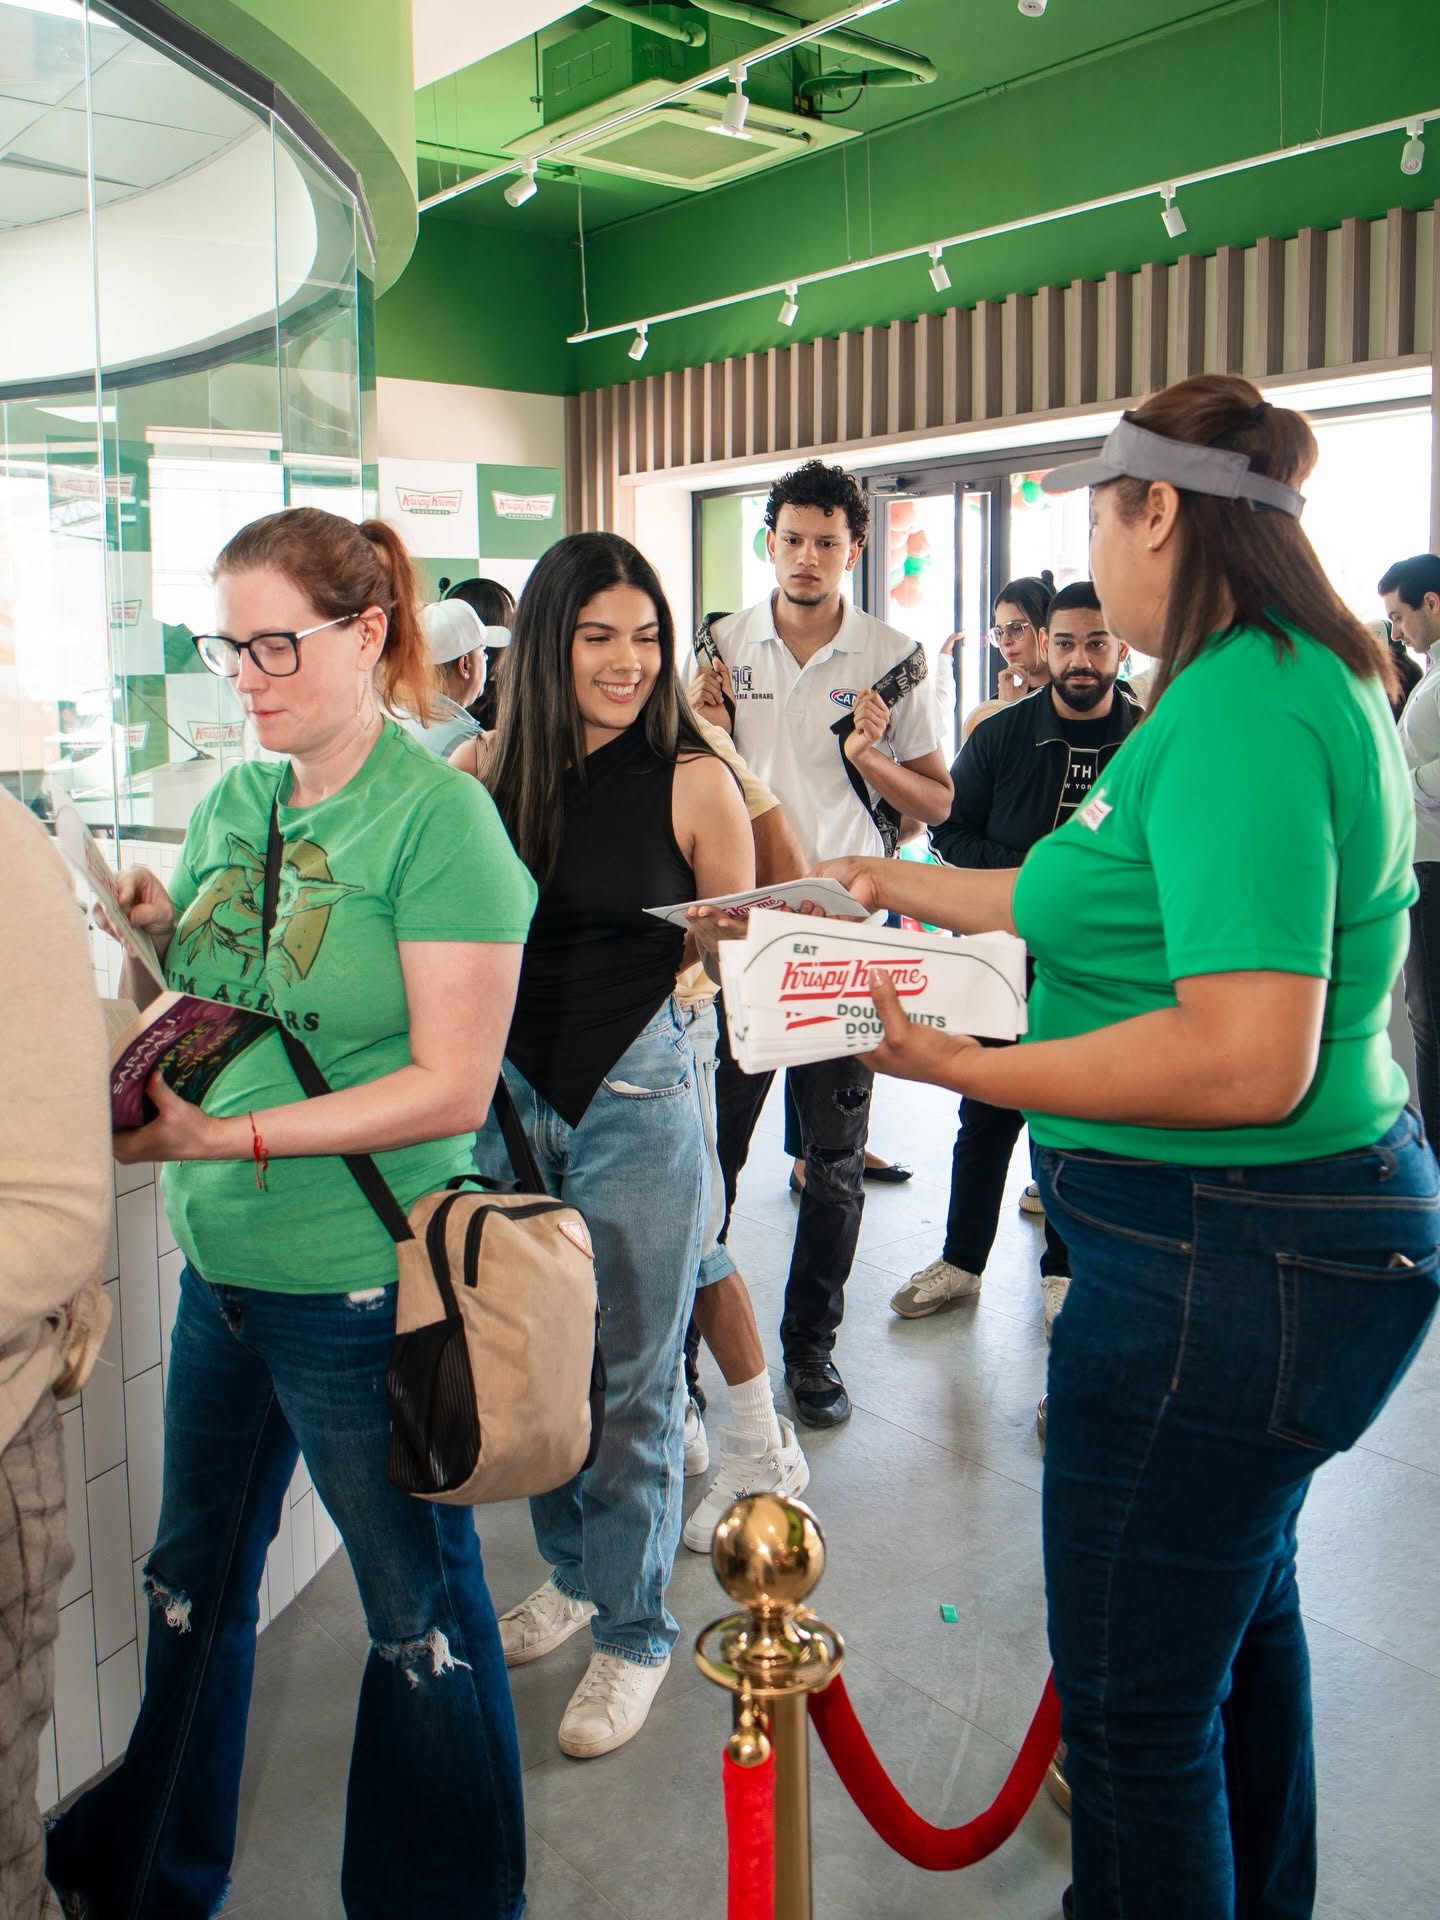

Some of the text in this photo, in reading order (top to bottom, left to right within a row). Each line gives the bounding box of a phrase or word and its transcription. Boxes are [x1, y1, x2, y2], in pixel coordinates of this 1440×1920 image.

[793, 943, 819, 956] EAT
[779, 959, 928, 1002] Krispy Kme
[212, 984, 272, 1012] ALL
[284, 1010, 320, 1031] RS
[113, 1030, 163, 1095] SARAH
[131, 1030, 177, 1080] MAAS
[173, 1025, 239, 1093] TORMS
